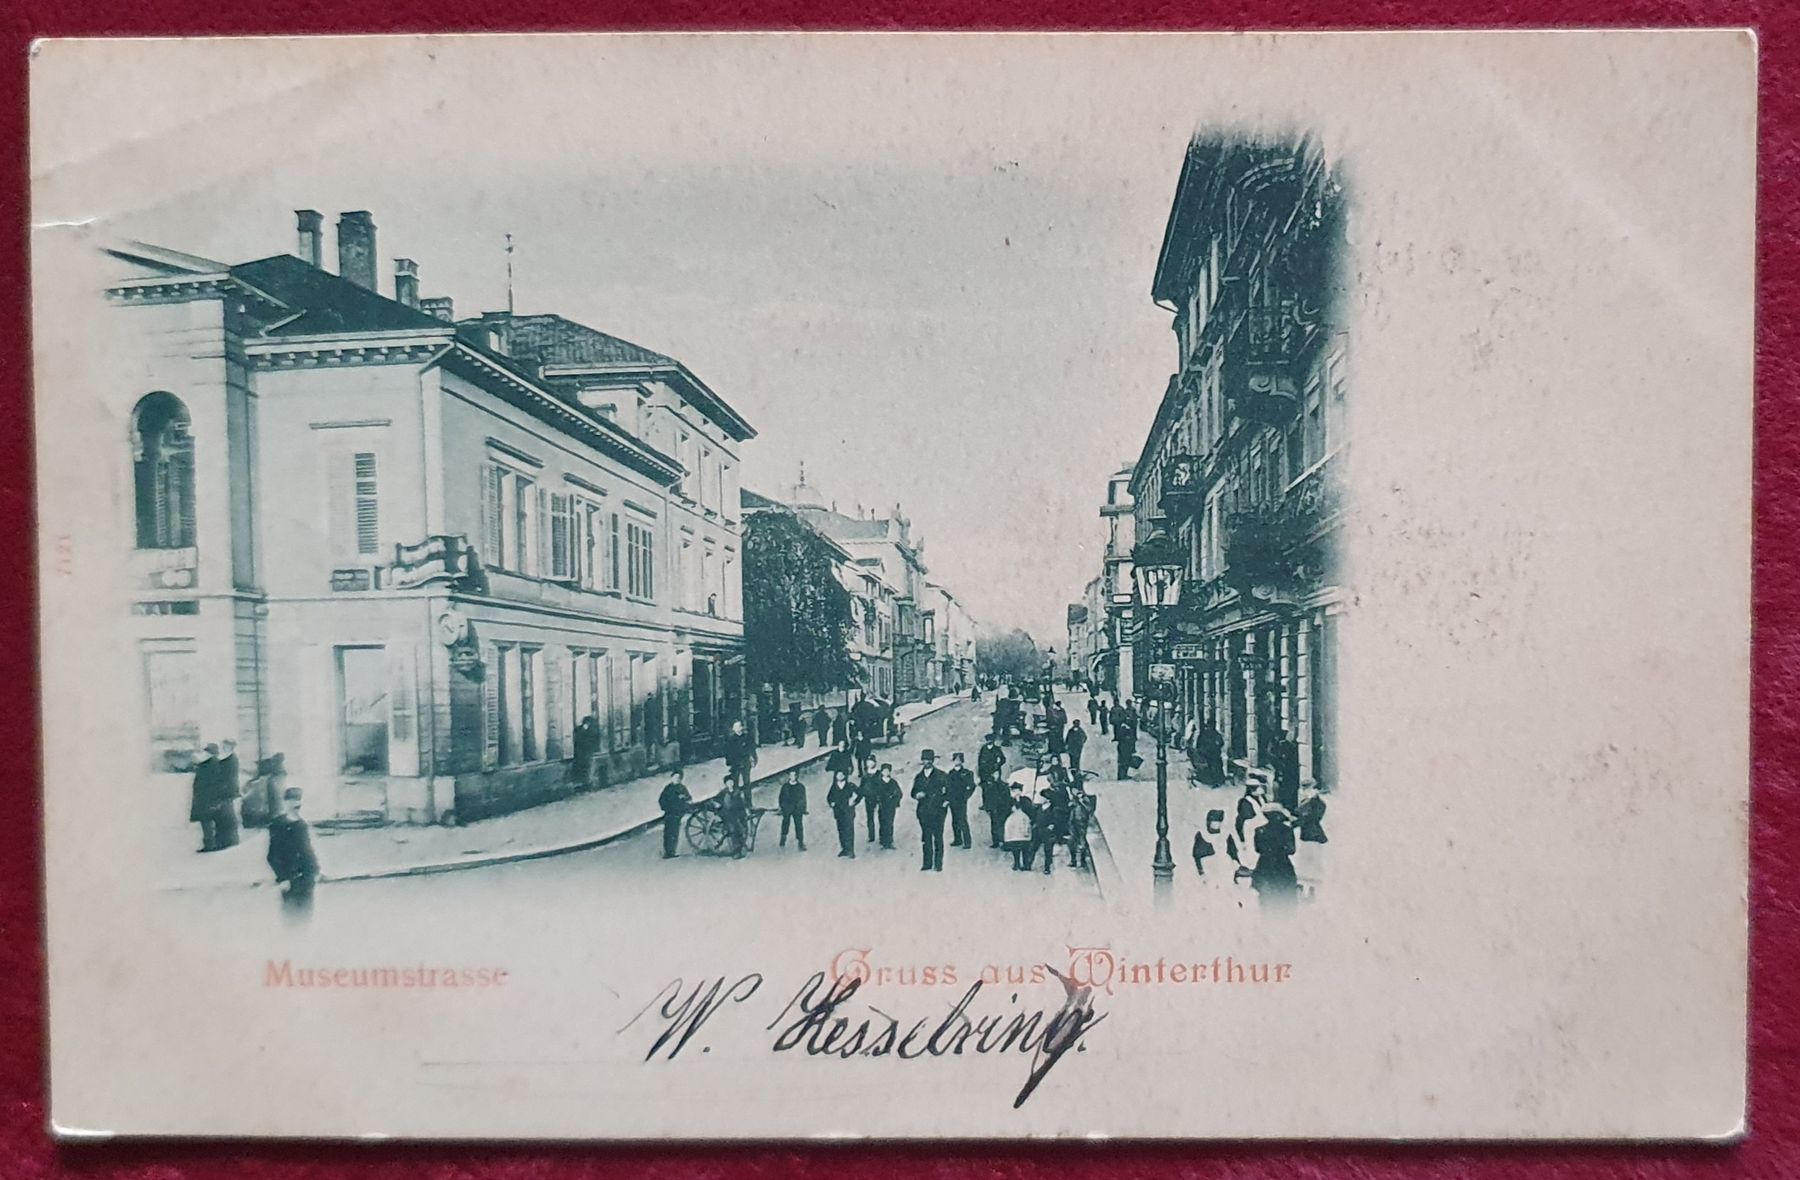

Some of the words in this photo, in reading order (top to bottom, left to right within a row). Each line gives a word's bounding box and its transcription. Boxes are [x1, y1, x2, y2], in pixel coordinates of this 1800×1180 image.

[264, 958, 508, 988] Museumstrasse
[830, 948, 958, 991] Gruss
[979, 963, 1047, 985] aus
[1065, 944, 1293, 996] Winterthur
